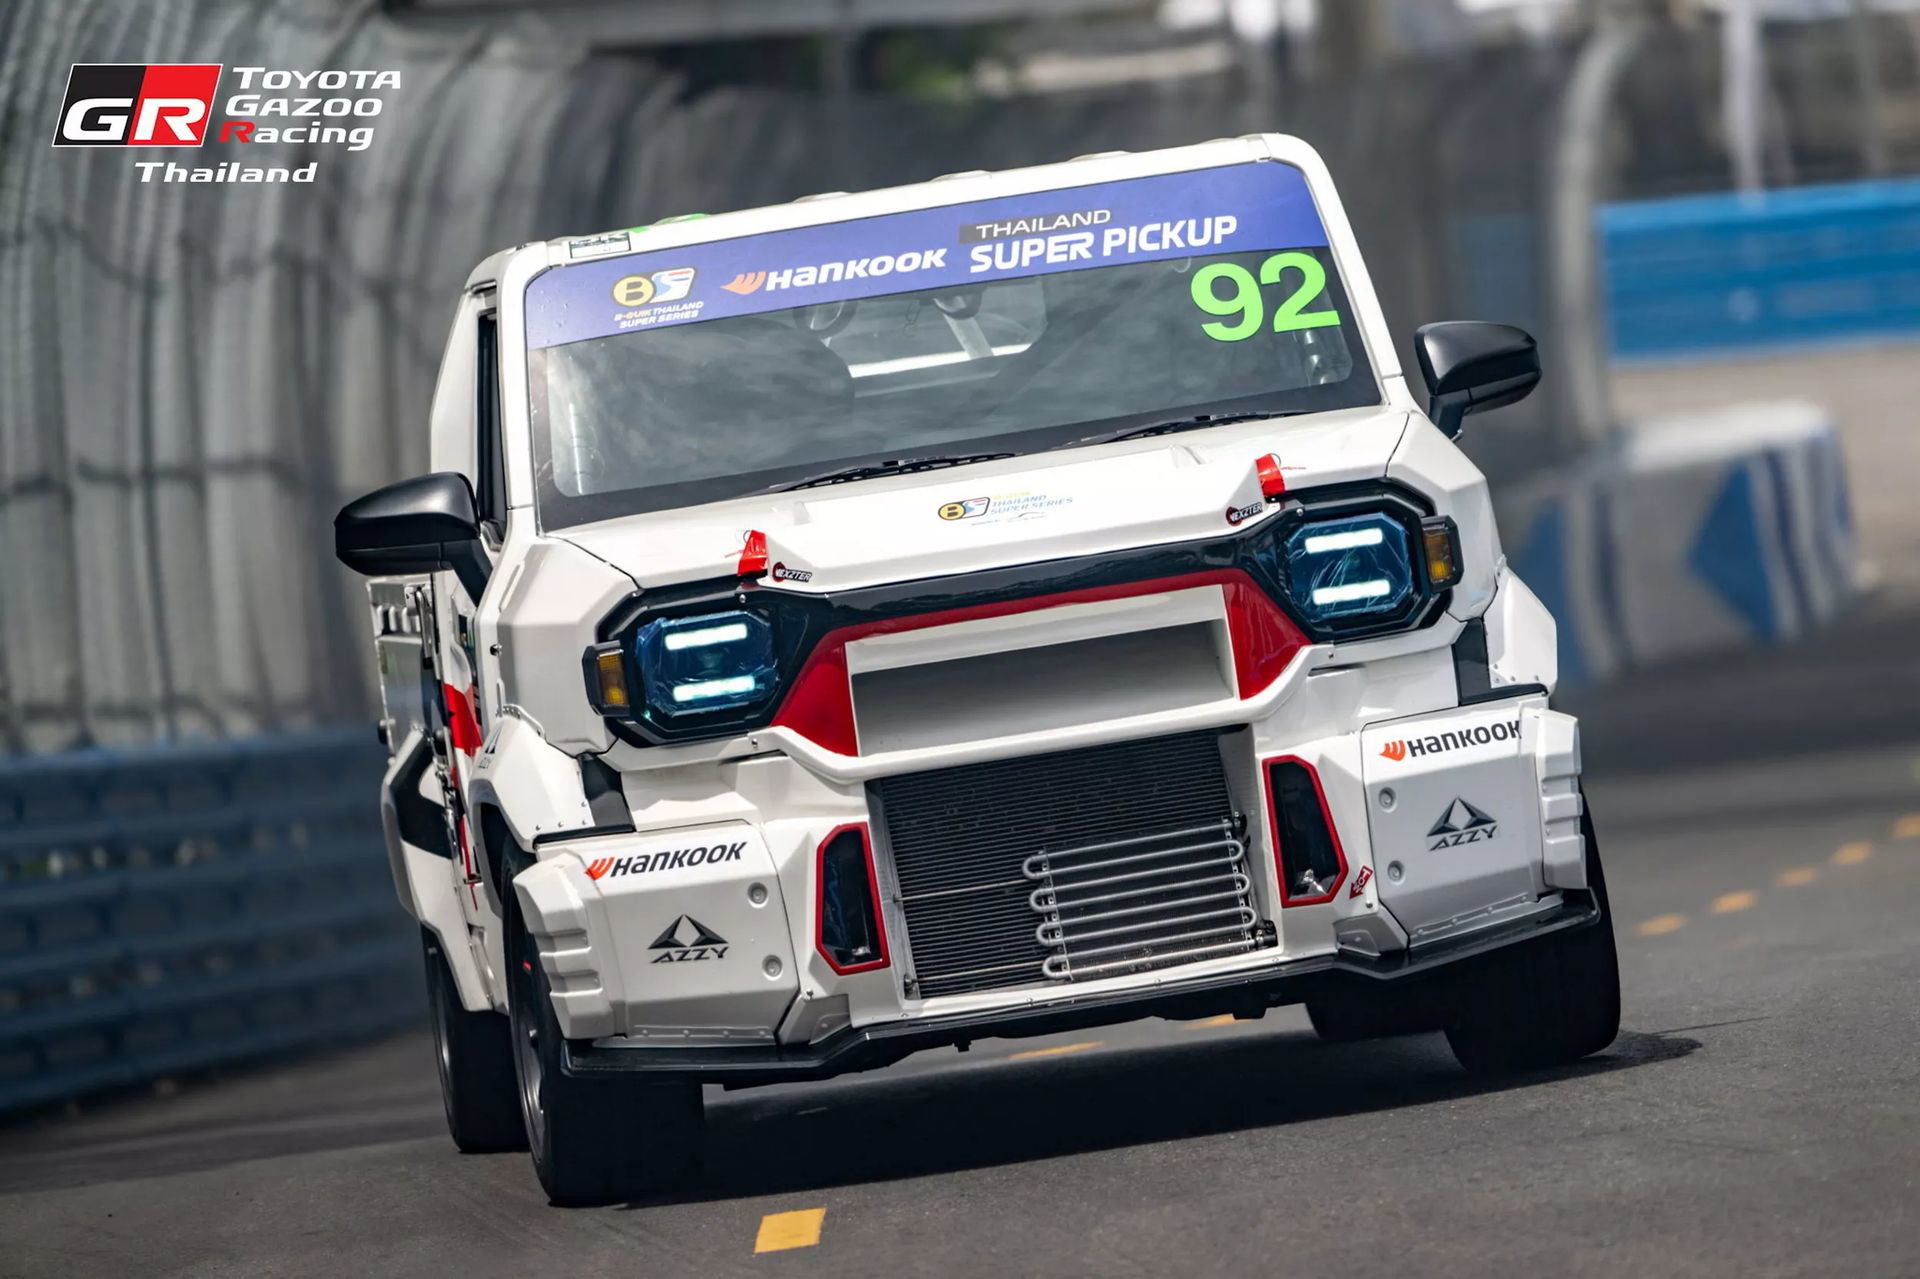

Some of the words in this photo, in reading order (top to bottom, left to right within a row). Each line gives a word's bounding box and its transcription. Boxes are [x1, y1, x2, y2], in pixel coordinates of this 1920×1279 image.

[976, 209, 1111, 239] THAILAND
[969, 232, 1094, 273] SUPER
[1102, 215, 1237, 256] PICKUP
[653, 301, 704, 315] THAILAND
[1190, 252, 1341, 342] 92
[619, 316, 656, 329] SUPER
[657, 310, 700, 323] SERIES
[992, 495, 1047, 507] THAILAND
[1428, 825, 1498, 852] AZZY
[650, 946, 730, 964] AZZY
